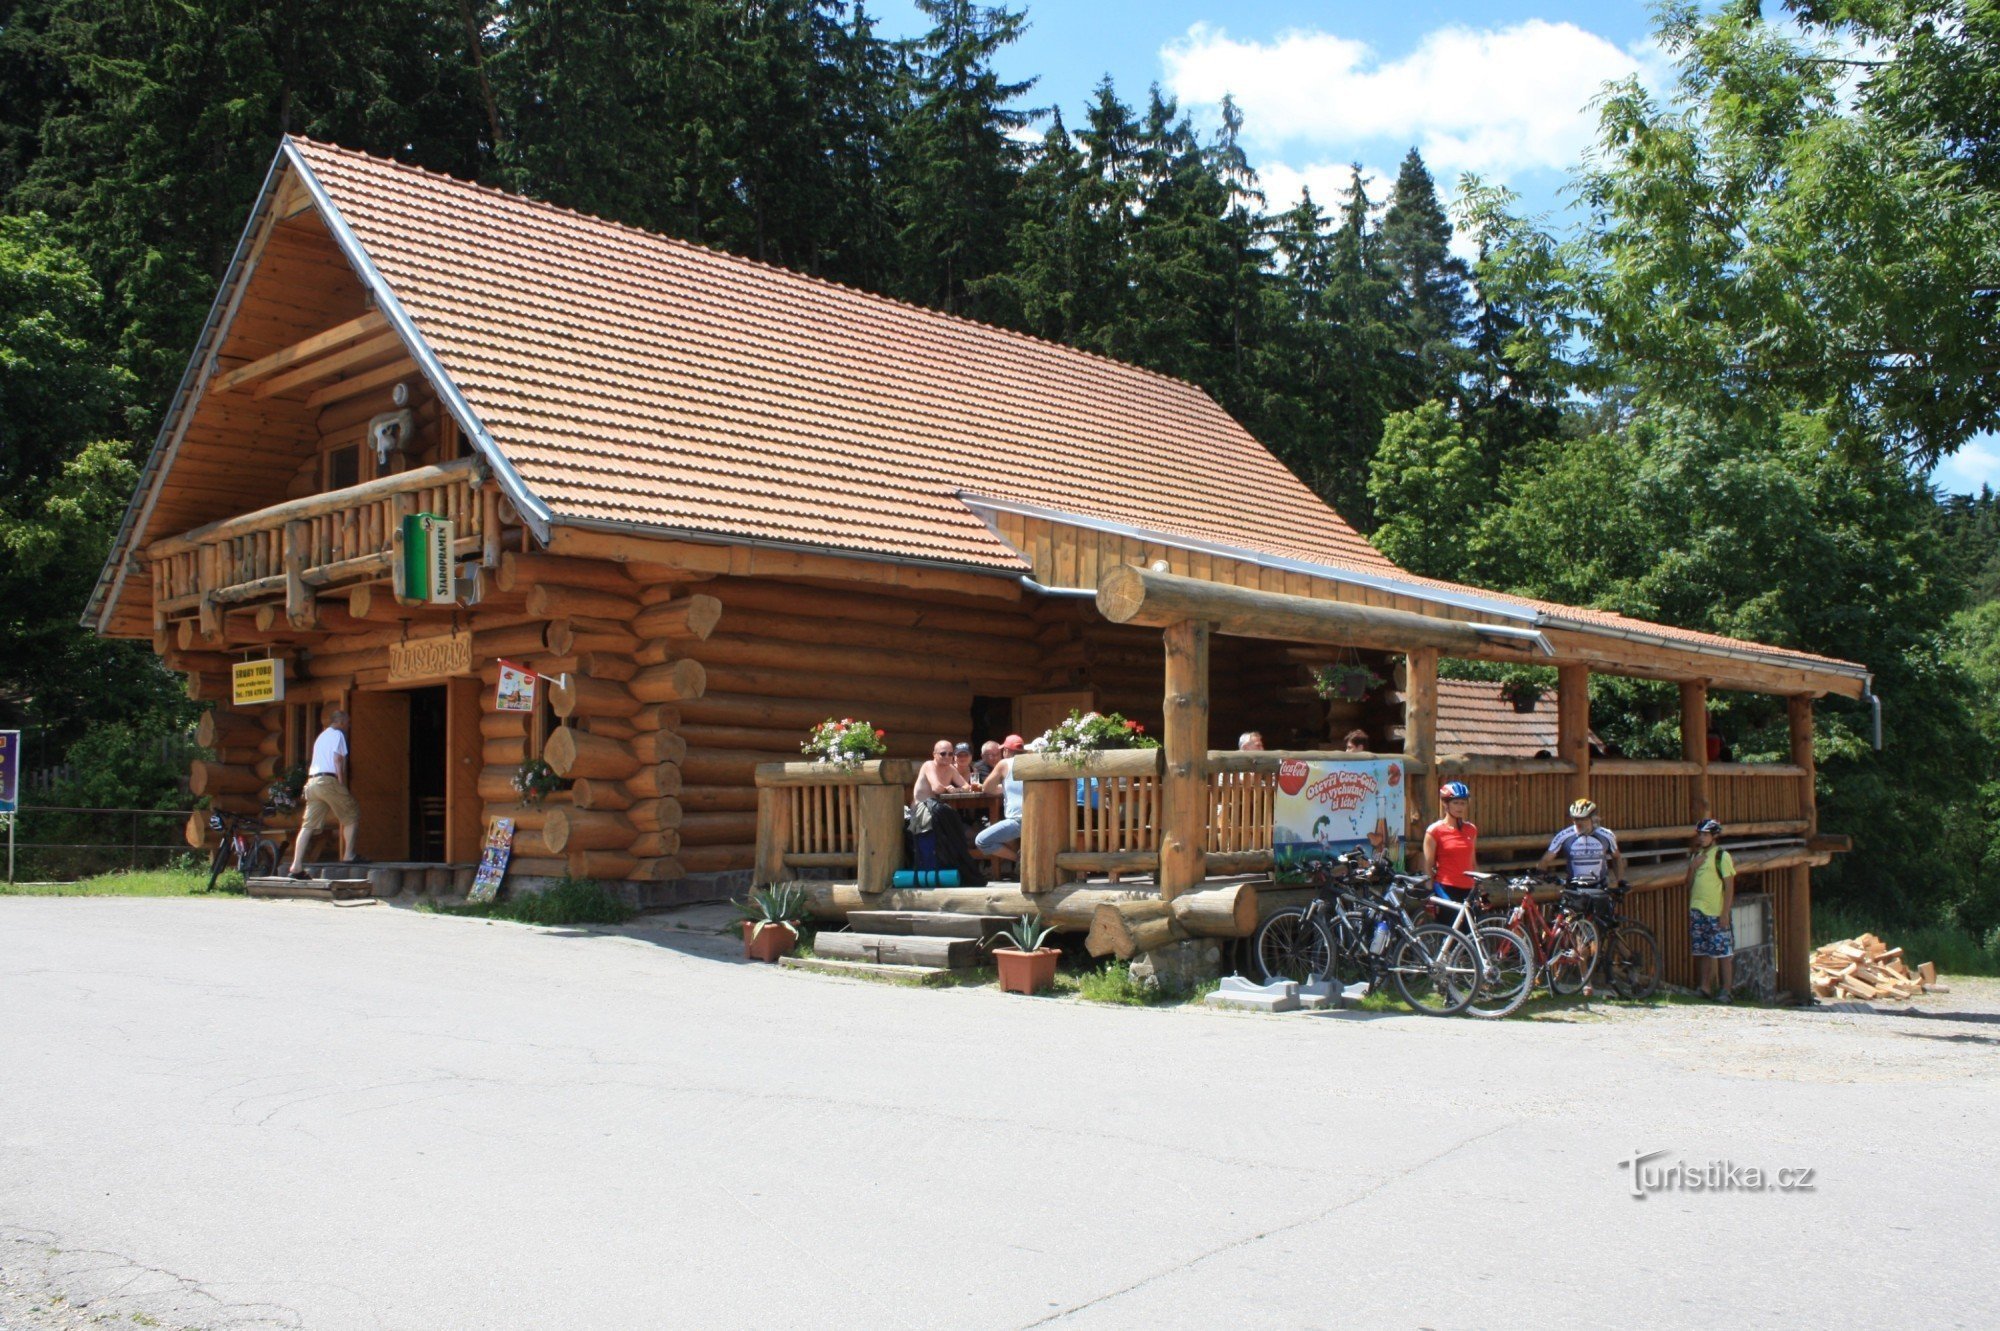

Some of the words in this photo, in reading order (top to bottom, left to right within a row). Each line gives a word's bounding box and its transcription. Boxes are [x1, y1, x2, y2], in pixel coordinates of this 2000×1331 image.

[437, 527, 449, 596] STAROPRAMEN
[1306, 773, 1337, 799] Otevři
[1321, 793, 1327, 803] a
[1329, 784, 1366, 801] vychutnej
[1332, 799, 1339, 810] si
[1340, 797, 1356, 809] léto!
